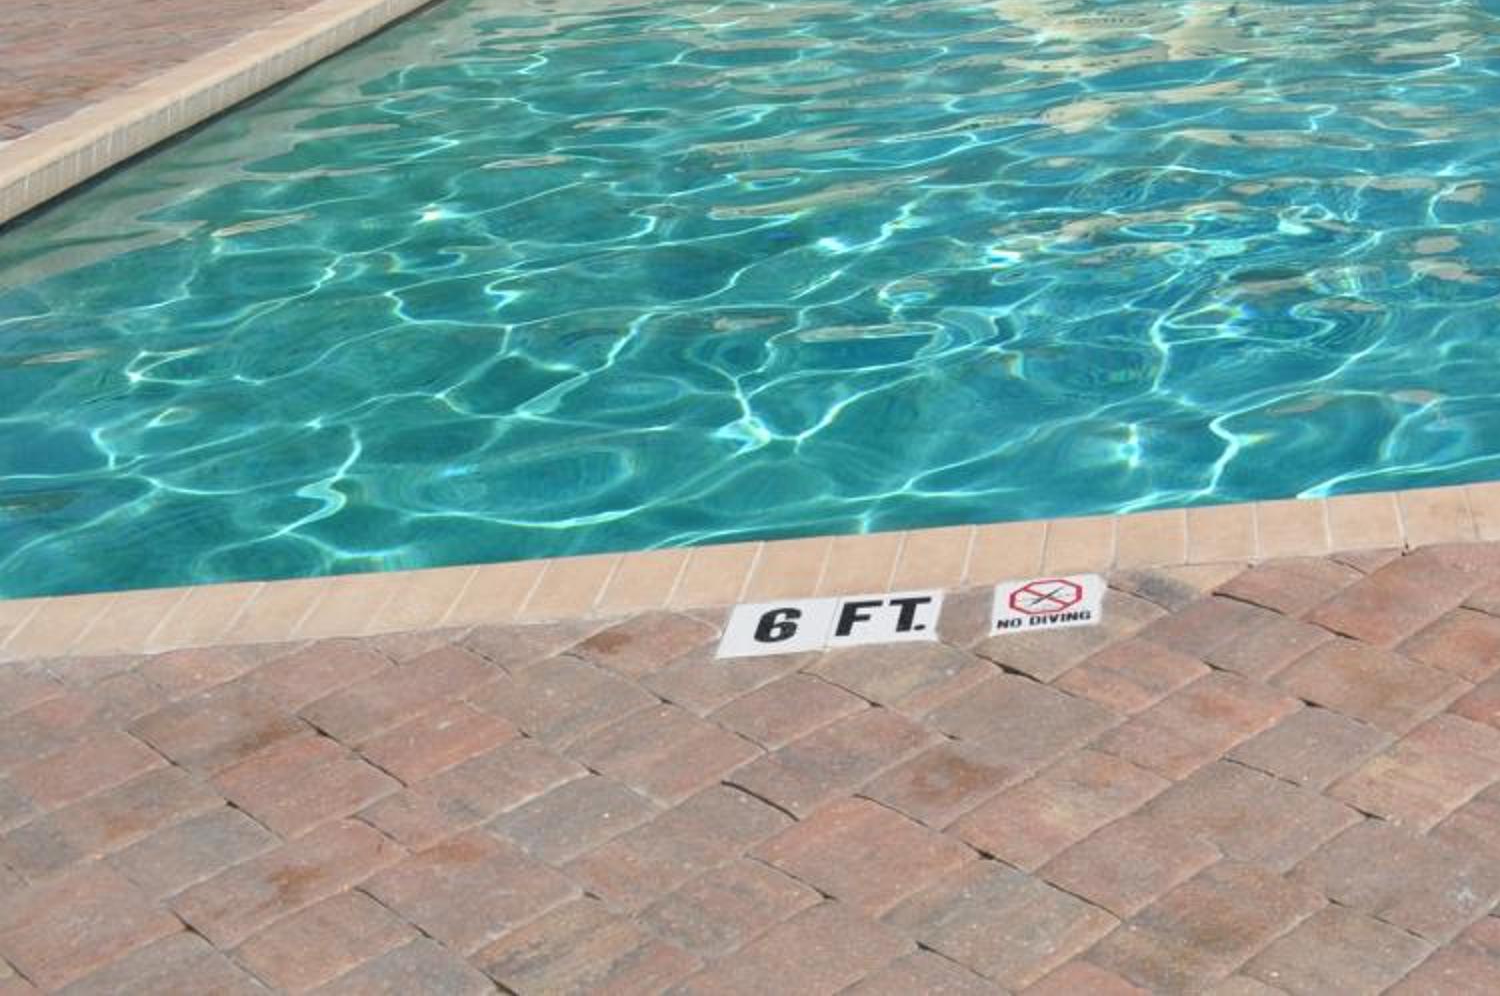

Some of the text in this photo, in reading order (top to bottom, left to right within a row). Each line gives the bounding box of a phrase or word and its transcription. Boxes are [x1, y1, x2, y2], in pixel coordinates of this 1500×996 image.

[754, 596, 932, 642] 6 FT.
[997, 610, 1091, 629] NO DIVING
